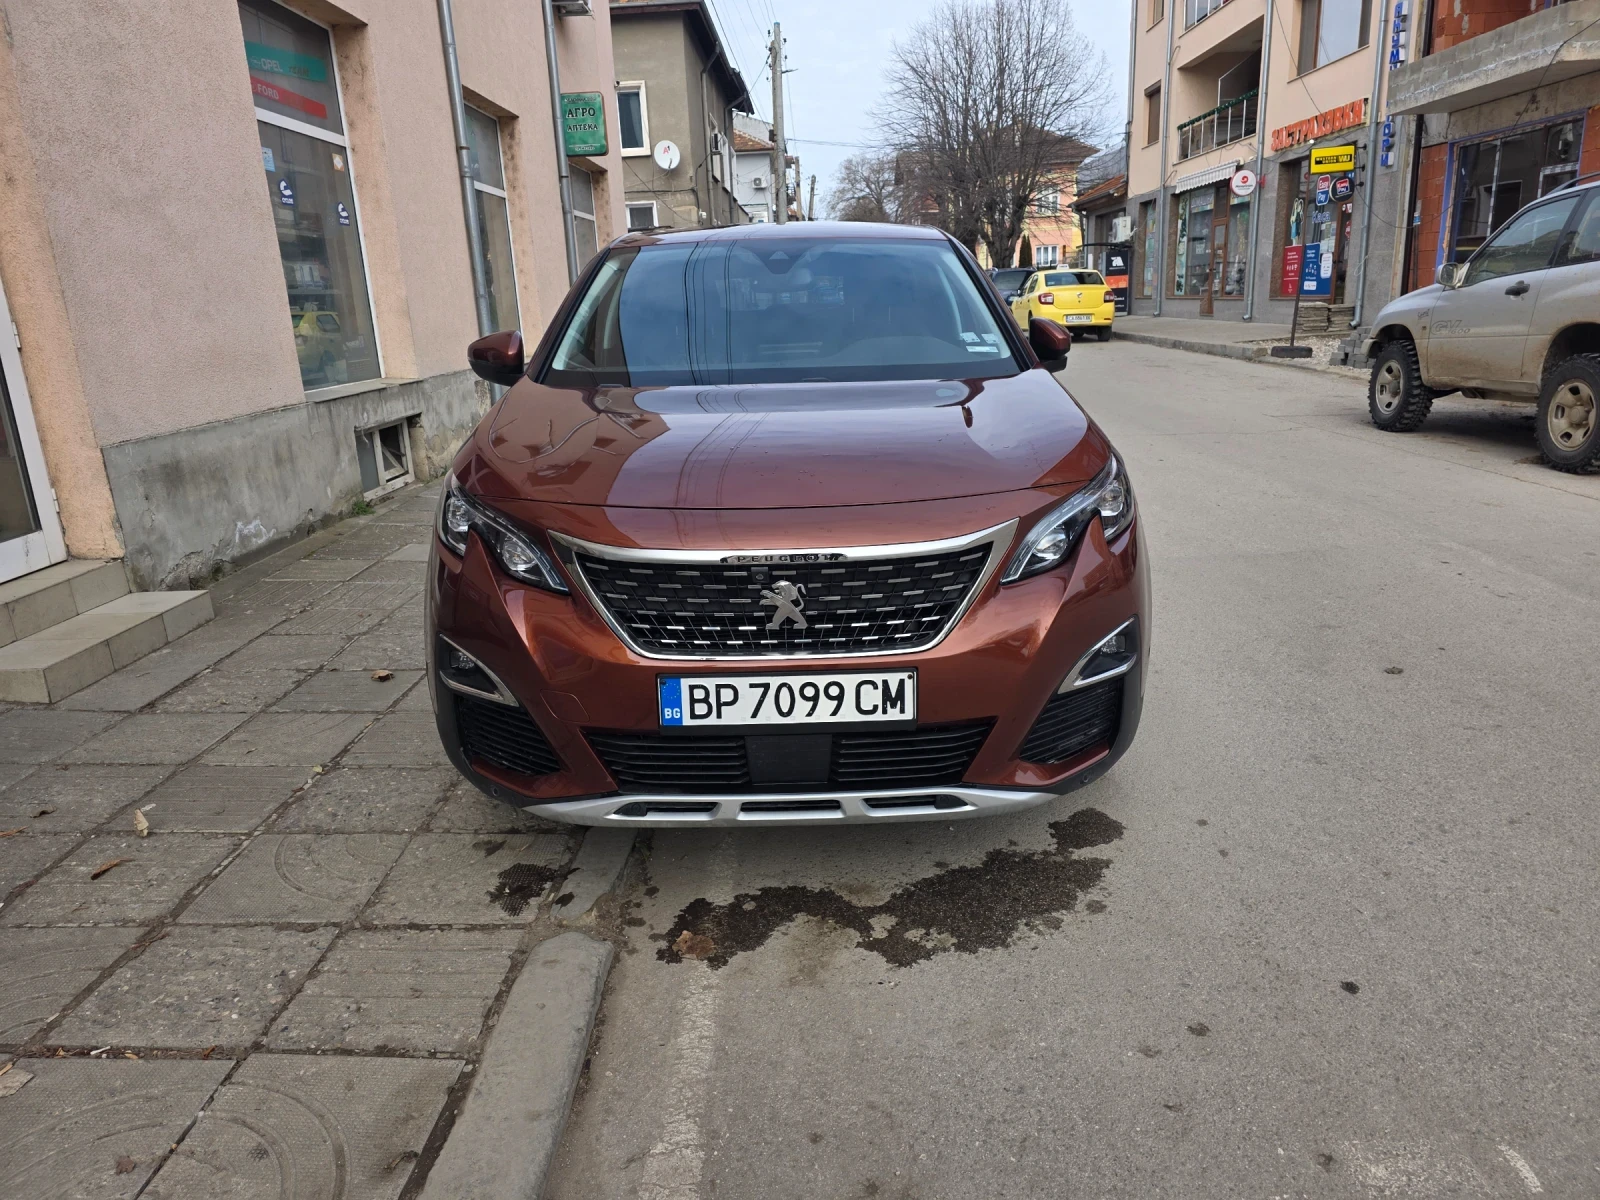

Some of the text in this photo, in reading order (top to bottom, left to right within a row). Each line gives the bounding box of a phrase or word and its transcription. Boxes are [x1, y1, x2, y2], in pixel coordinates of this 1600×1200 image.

[261, 58, 283, 72] OPEL
[257, 84, 279, 100] FORD
[567, 107, 596, 118] АГРО
[567, 123, 598, 132] АПТЕКА
[1271, 98, 1363, 153] ЗАСТРАХОВКИ
[1319, 180, 1329, 190] Easy
[1318, 192, 1326, 202] Pay
[1312, 210, 1331, 223] Каса
[737, 553, 836, 563] PEUGEOT
[688, 678, 906, 720] BP 7099 CM
[664, 707, 681, 719] BG
